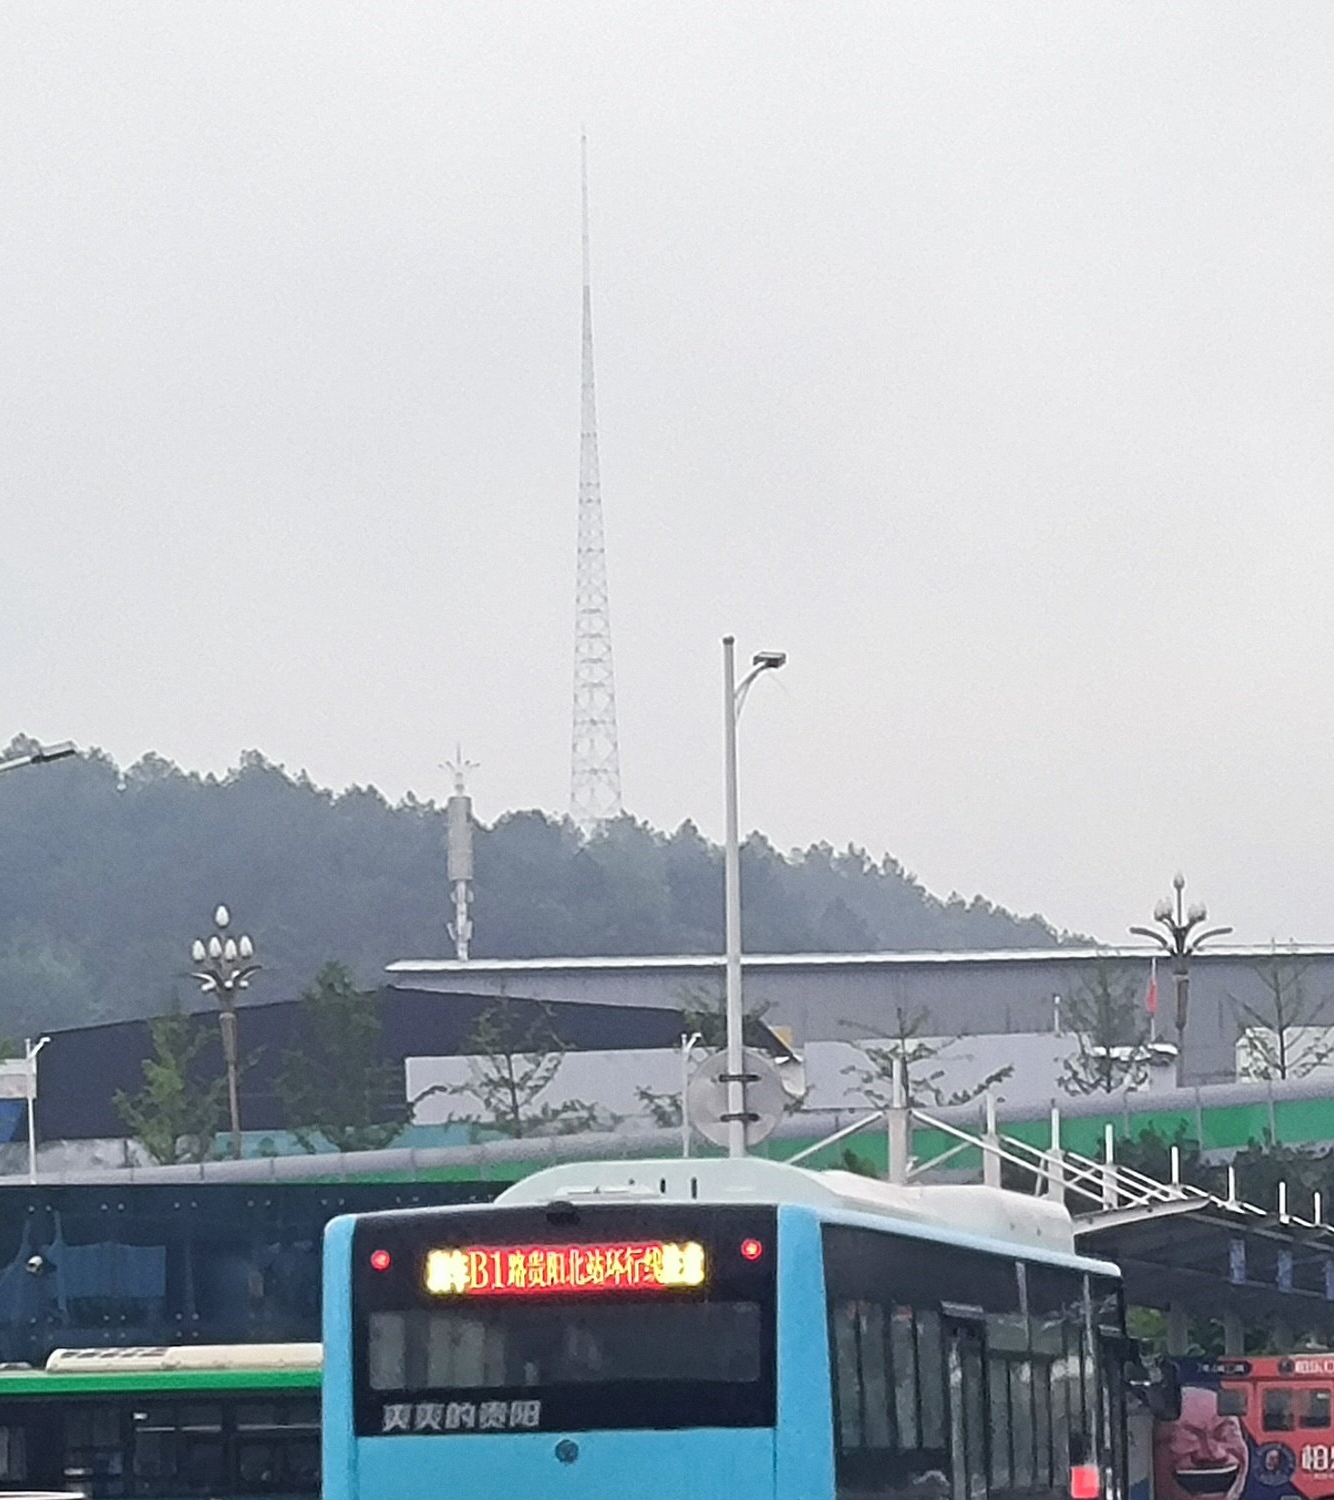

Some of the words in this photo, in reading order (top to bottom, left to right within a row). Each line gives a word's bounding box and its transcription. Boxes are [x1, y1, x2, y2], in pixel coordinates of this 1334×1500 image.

[382, 1400, 541, 1432] 爽爽的贵阳
